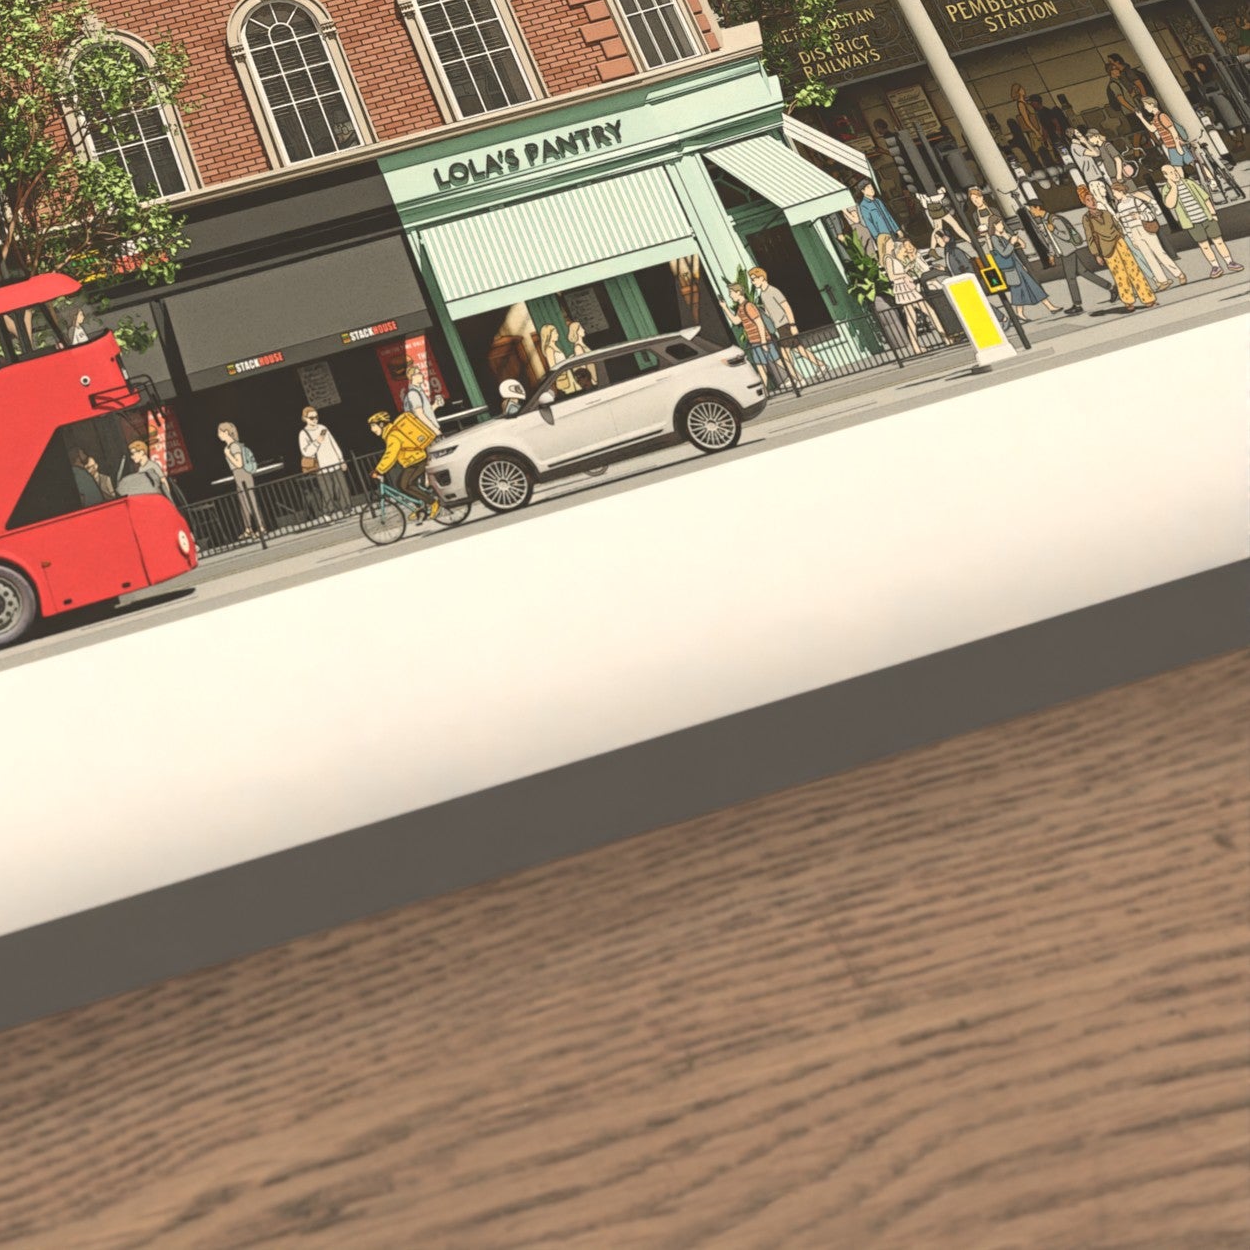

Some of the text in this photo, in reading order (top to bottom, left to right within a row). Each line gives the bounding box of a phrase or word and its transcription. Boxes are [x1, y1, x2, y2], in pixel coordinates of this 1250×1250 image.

[984, 1, 1059, 33] STATION
[803, 48, 882, 80] RAILWAYS
[433, 119, 622, 191] LOLA'S PANTRY
[349, 320, 398, 342] STACKHOUSE
[235, 351, 284, 374] STACKHOUSE
